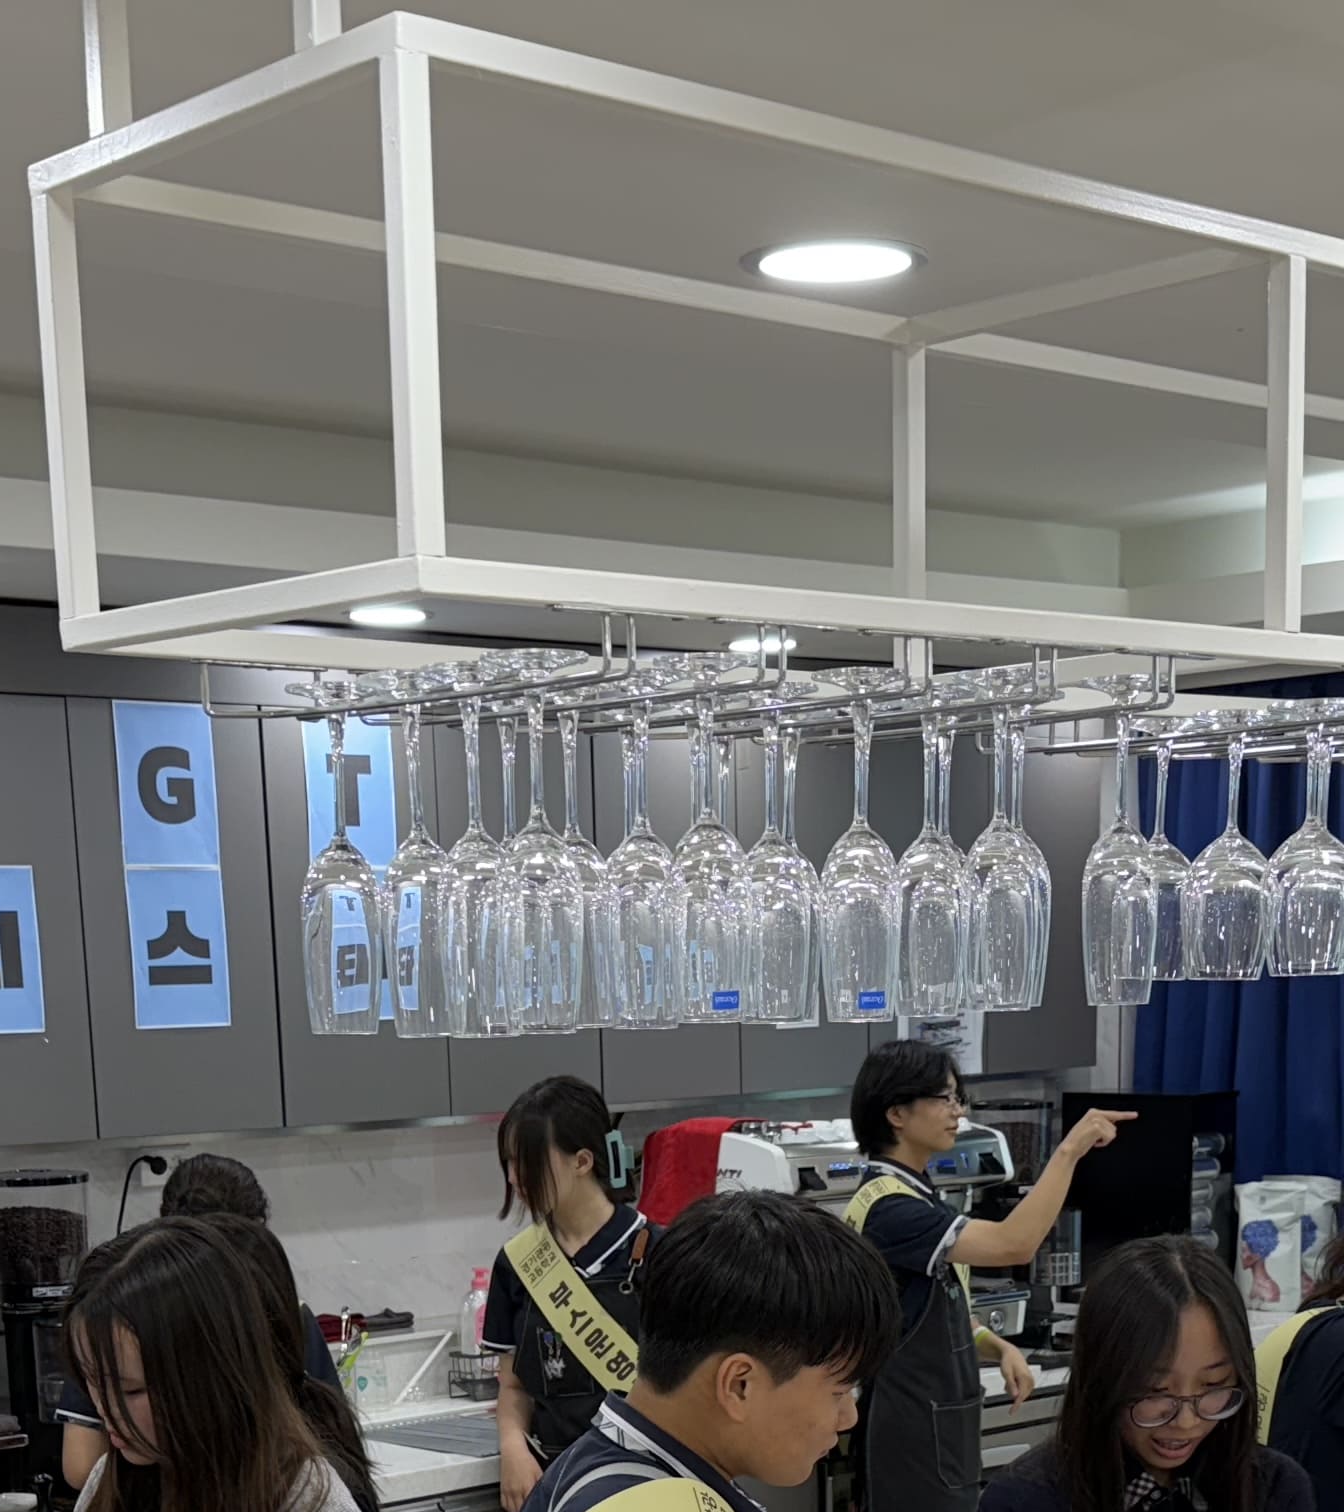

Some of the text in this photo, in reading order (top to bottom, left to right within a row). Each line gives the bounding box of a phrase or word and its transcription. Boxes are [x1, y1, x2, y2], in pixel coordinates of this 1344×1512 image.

[137, 746, 372, 828] G T
[147, 910, 213, 986] 스
